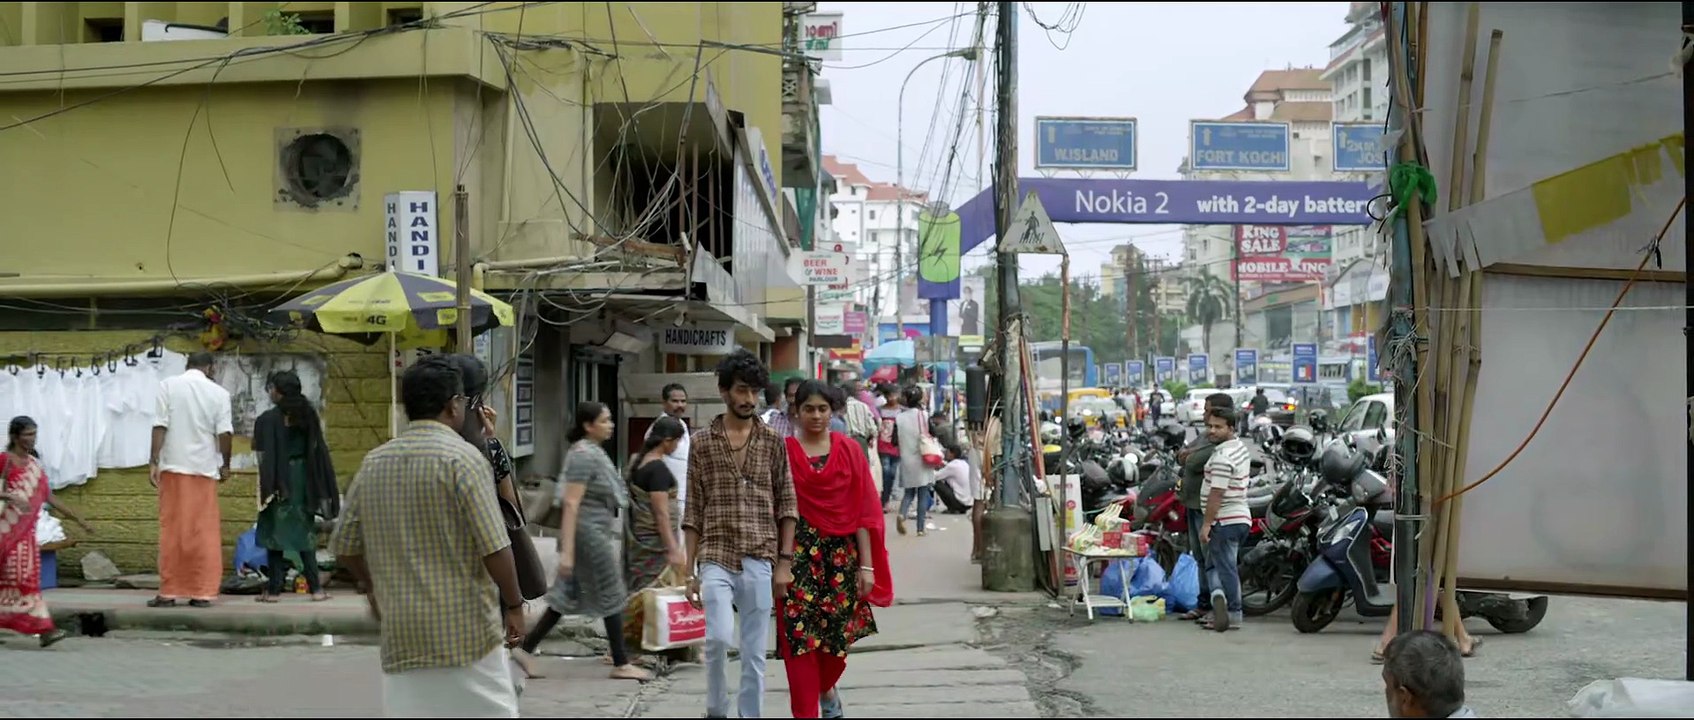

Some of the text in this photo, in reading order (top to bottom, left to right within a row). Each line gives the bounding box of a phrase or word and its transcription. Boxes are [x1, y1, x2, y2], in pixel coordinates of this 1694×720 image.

[1054, 147, 1119, 161] W.ISLAND
[1197, 150, 1285, 164] FORT KOCHI
[1075, 189, 1147, 214] Nokia
[1154, 192, 1169, 214] 2
[1196, 195, 1239, 213] with
[1244, 195, 1300, 218] 2-day
[410, 202, 429, 270] HANDI
[1241, 225, 1280, 239] KING
[1241, 239, 1281, 253] SALE
[803, 259, 827, 267] BEER
[1237, 261, 1289, 273] MOBILE
[366, 315, 387, 326] 4G
[665, 329, 726, 346] HANDICRAFTS
